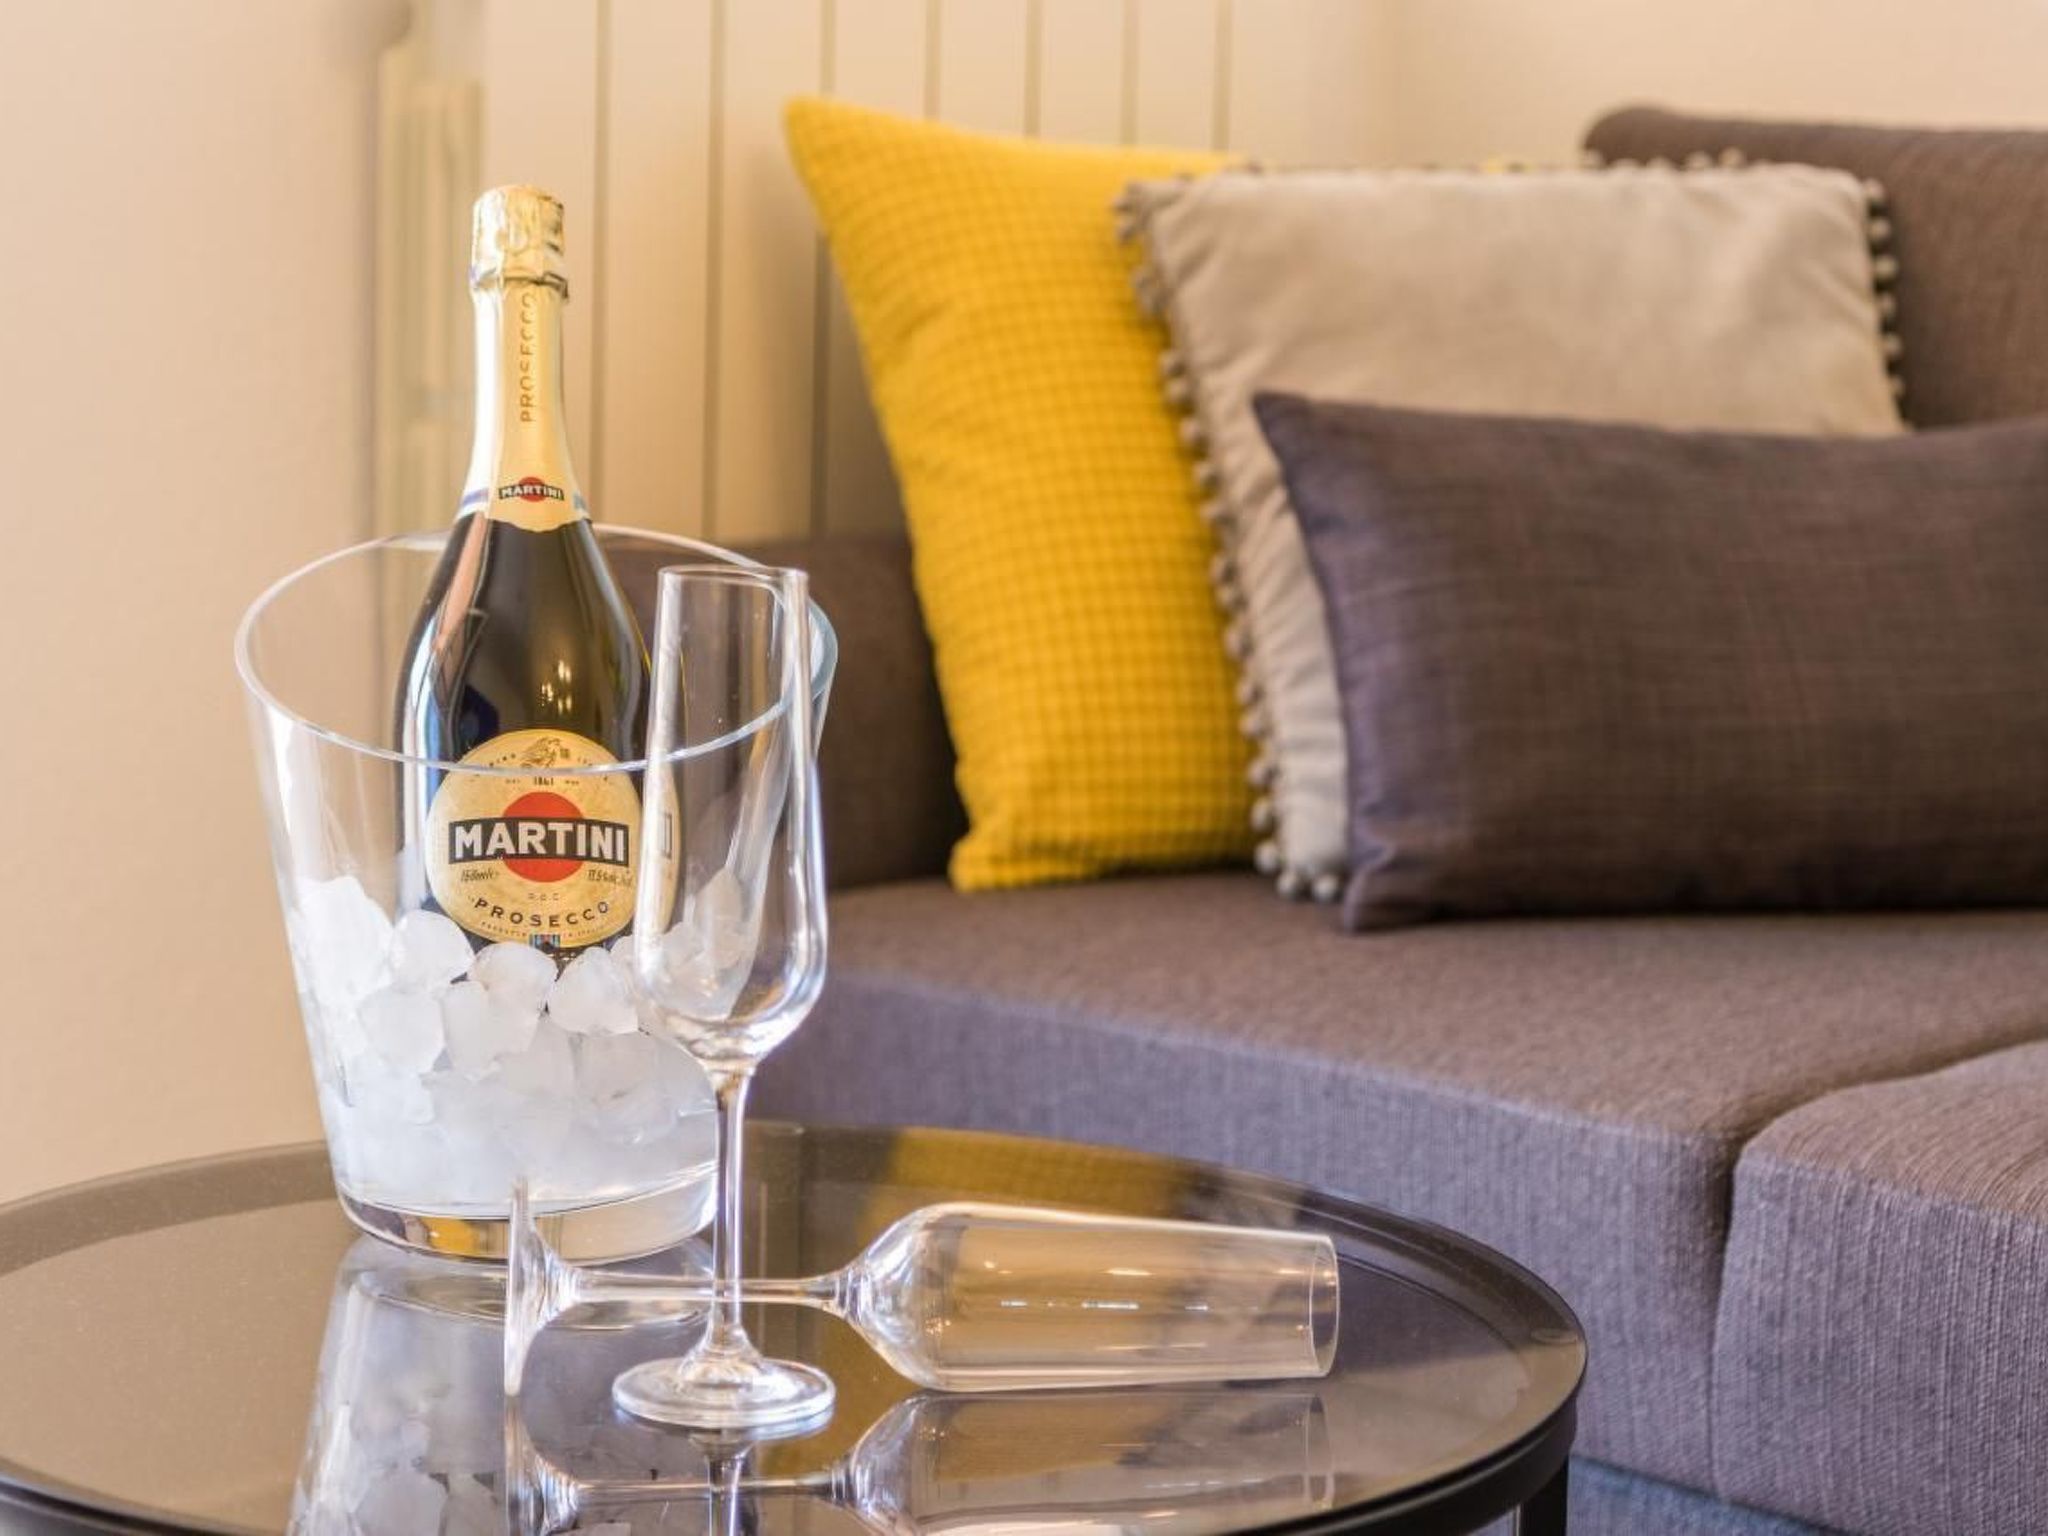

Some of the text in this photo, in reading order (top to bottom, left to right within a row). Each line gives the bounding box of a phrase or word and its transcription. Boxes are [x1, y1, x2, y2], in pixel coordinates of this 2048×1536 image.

[519, 293, 537, 423] PROSECCO
[501, 484, 563, 499] MARTINI
[455, 821, 625, 862] MARTINI
[474, 897, 608, 928] PROSECCO
